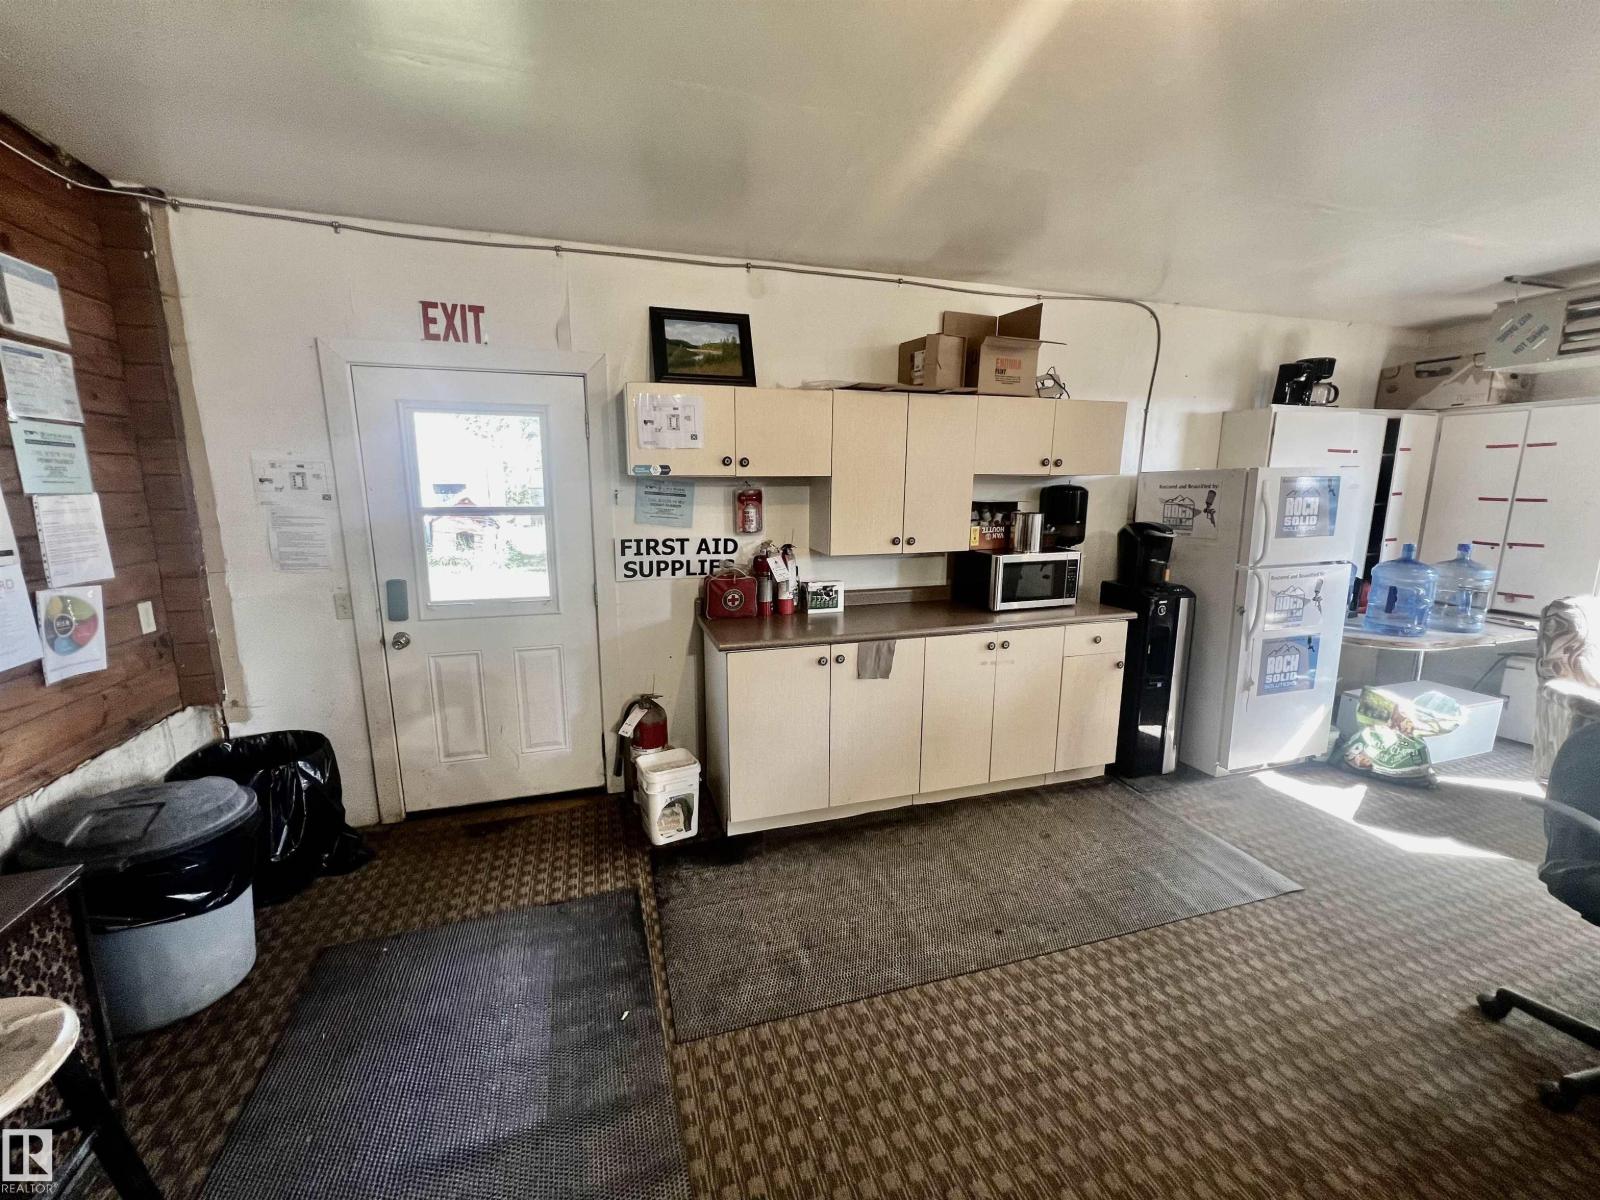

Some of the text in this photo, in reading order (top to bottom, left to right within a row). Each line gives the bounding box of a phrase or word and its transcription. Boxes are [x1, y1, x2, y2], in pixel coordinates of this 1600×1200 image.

[418, 301, 485, 344] EXIT
[1283, 515, 1318, 526] SOLID
[620, 537, 739, 556] FIRST AID
[1265, 671, 1298, 684] SOLID
